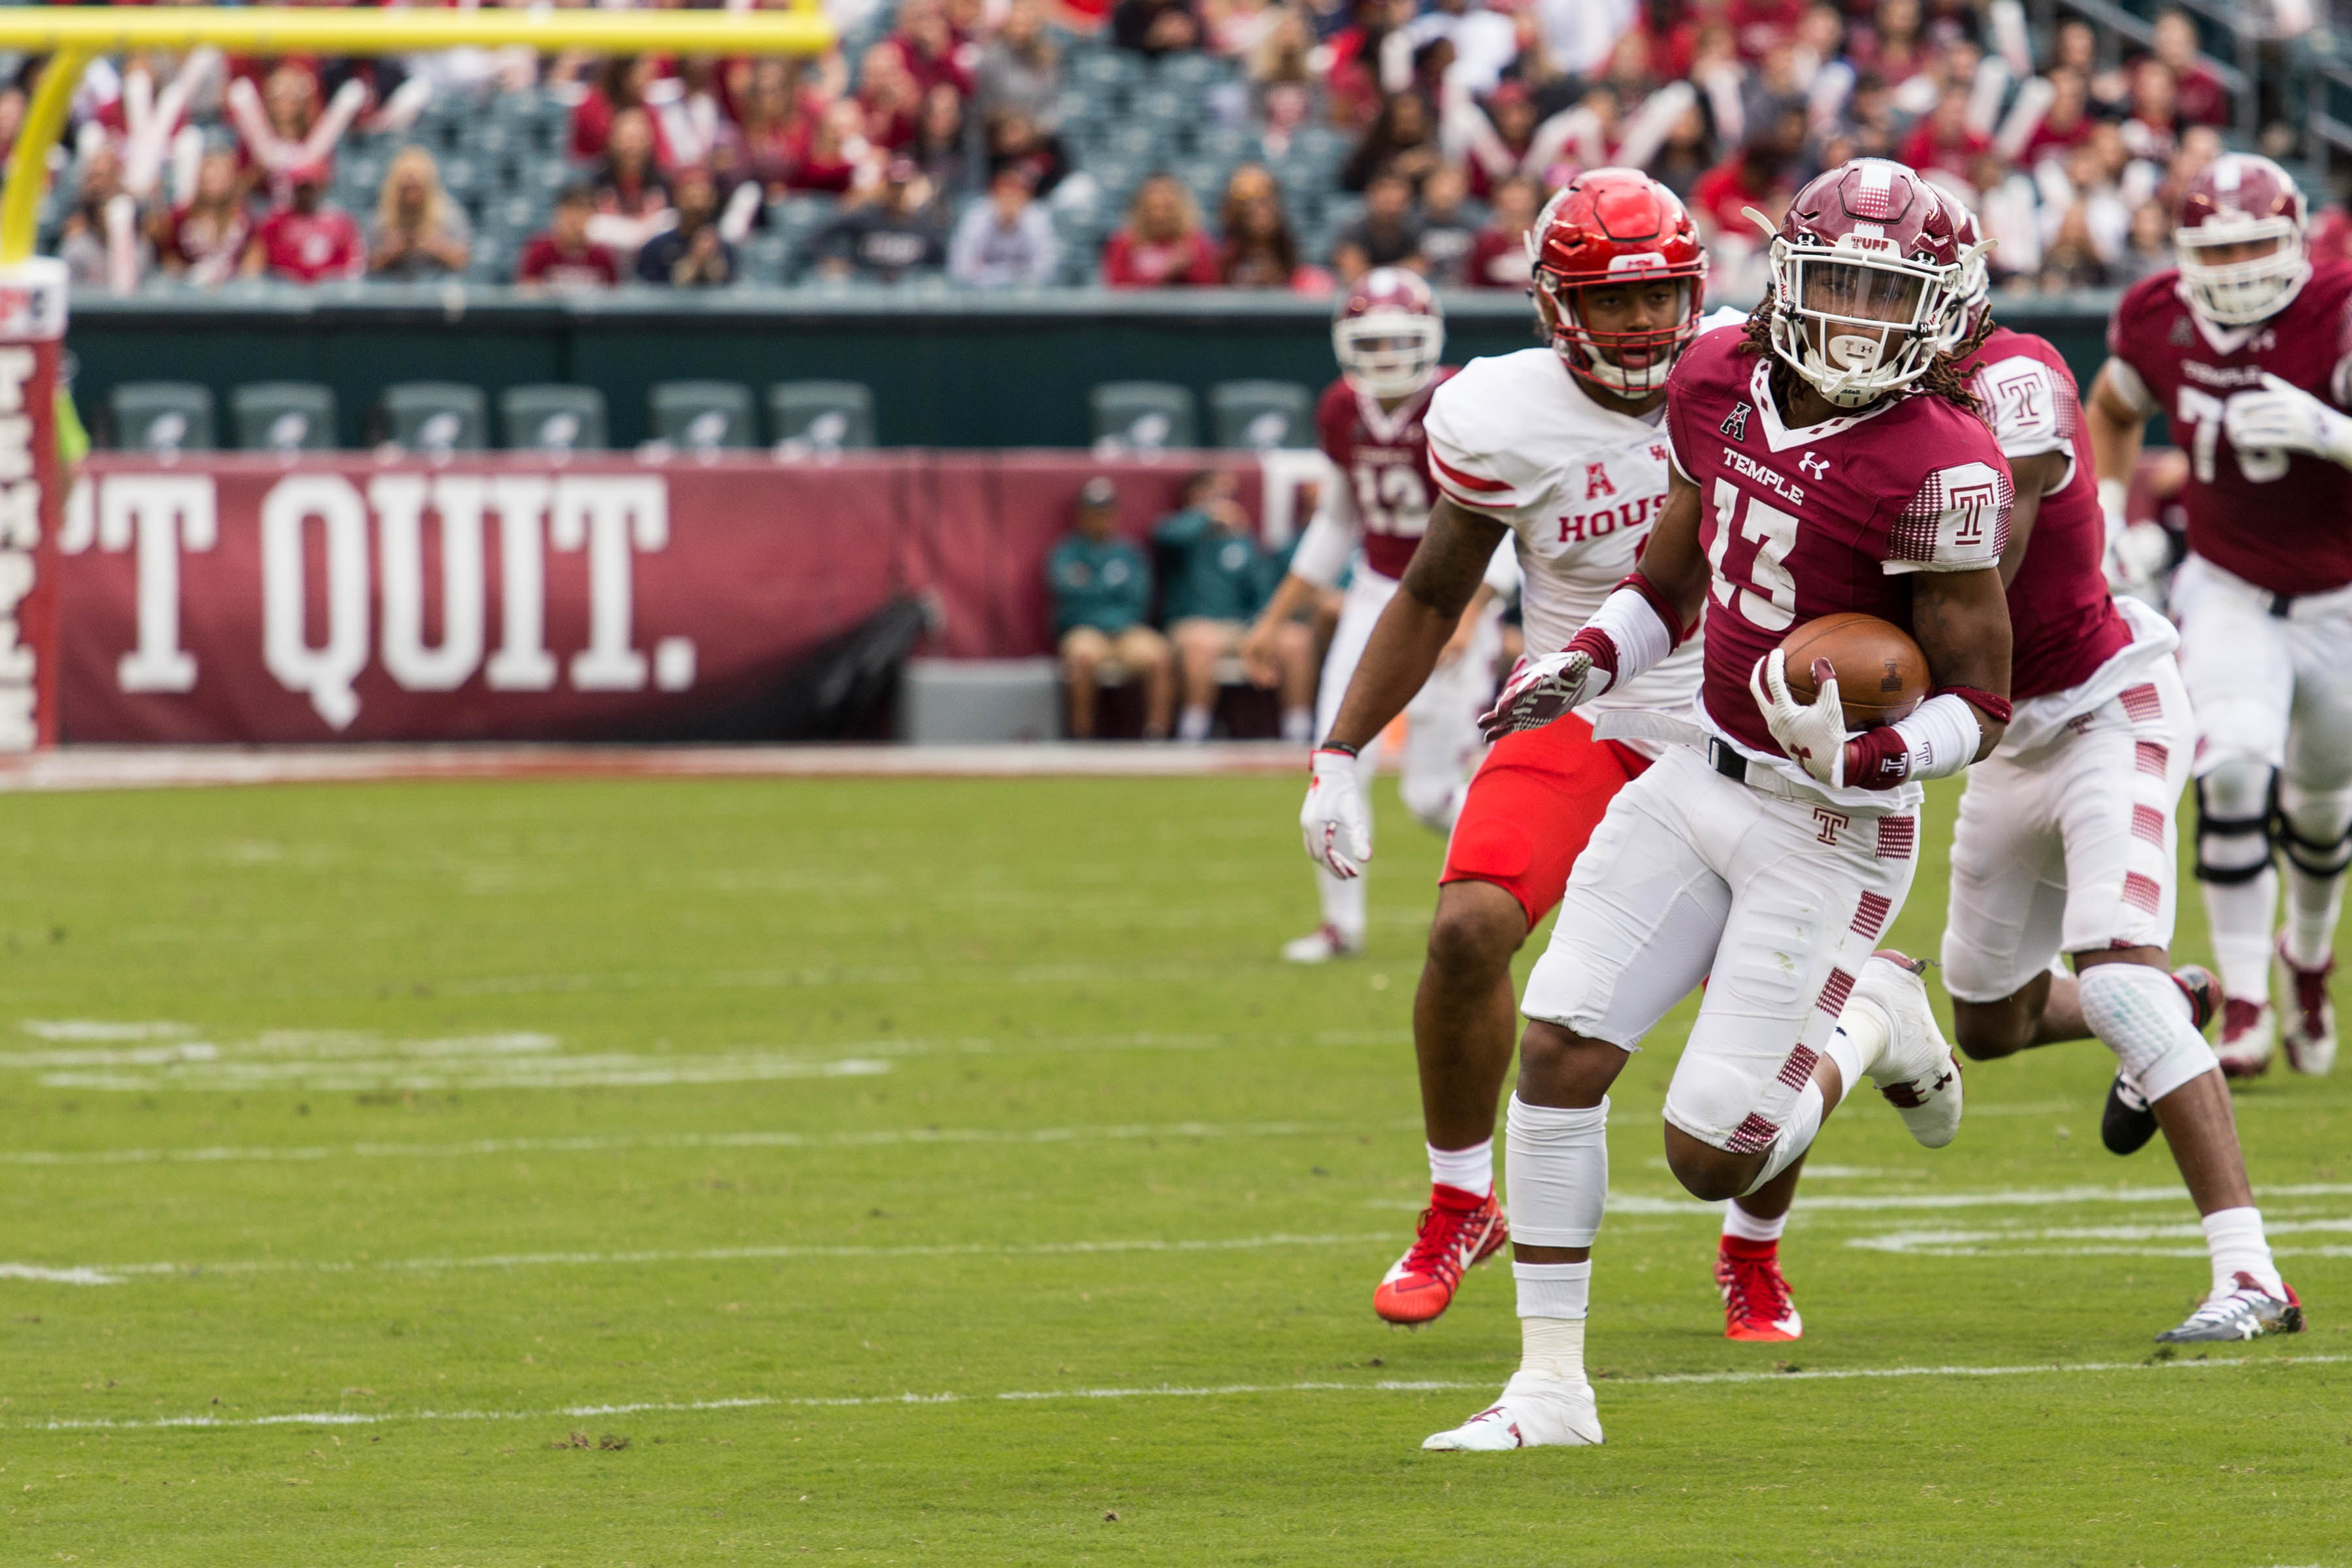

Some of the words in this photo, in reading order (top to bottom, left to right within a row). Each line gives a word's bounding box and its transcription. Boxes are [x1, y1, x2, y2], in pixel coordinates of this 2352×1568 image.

[1851, 236, 1889, 252] TUFF
[1720, 401, 1751, 441] A
[1997, 372, 2043, 427] T
[1586, 462, 1616, 500] A
[1723, 447, 1805, 507] TEMPLE
[1950, 482, 1995, 546] T
[1708, 477, 1800, 632] 13
[264, 474, 696, 730] QUIT.
[1881, 752, 1908, 777] T
[1813, 807, 1850, 846] T
